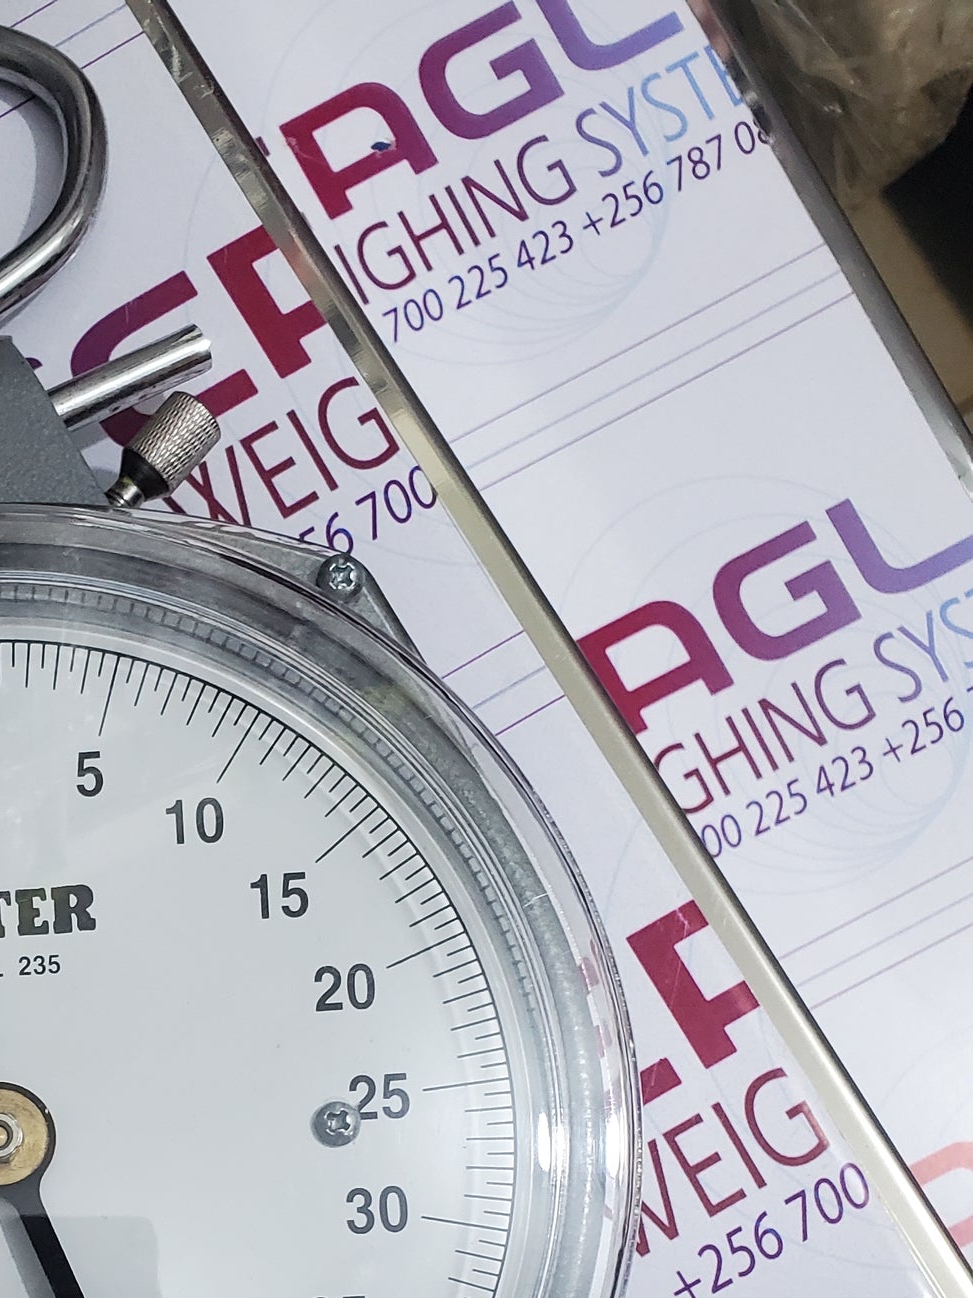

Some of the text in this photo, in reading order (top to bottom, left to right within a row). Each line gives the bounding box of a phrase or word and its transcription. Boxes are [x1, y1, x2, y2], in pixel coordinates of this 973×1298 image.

[255, 0, 685, 220] AGL
[334, 134, 577, 304] IGHING
[382, 289, 444, 343] 700
[447, 253, 509, 311] 225
[516, 221, 574, 272] 423
[582, 170, 664, 236] +256
[665, 133, 722, 192] 787
[355, 466, 438, 542] 700
[76, 750, 104, 797] 5
[746, 778, 808, 837] 225
[815, 746, 875, 798] 423
[882, 697, 965, 764] +256
[165, 797, 224, 844] 10
[250, 872, 309, 919] 15
[17, 955, 61, 976] 235
[313, 963, 376, 1012] 20
[348, 1073, 410, 1120] 25
[346, 1185, 408, 1234] 30
[784, 1163, 870, 1243] 700
